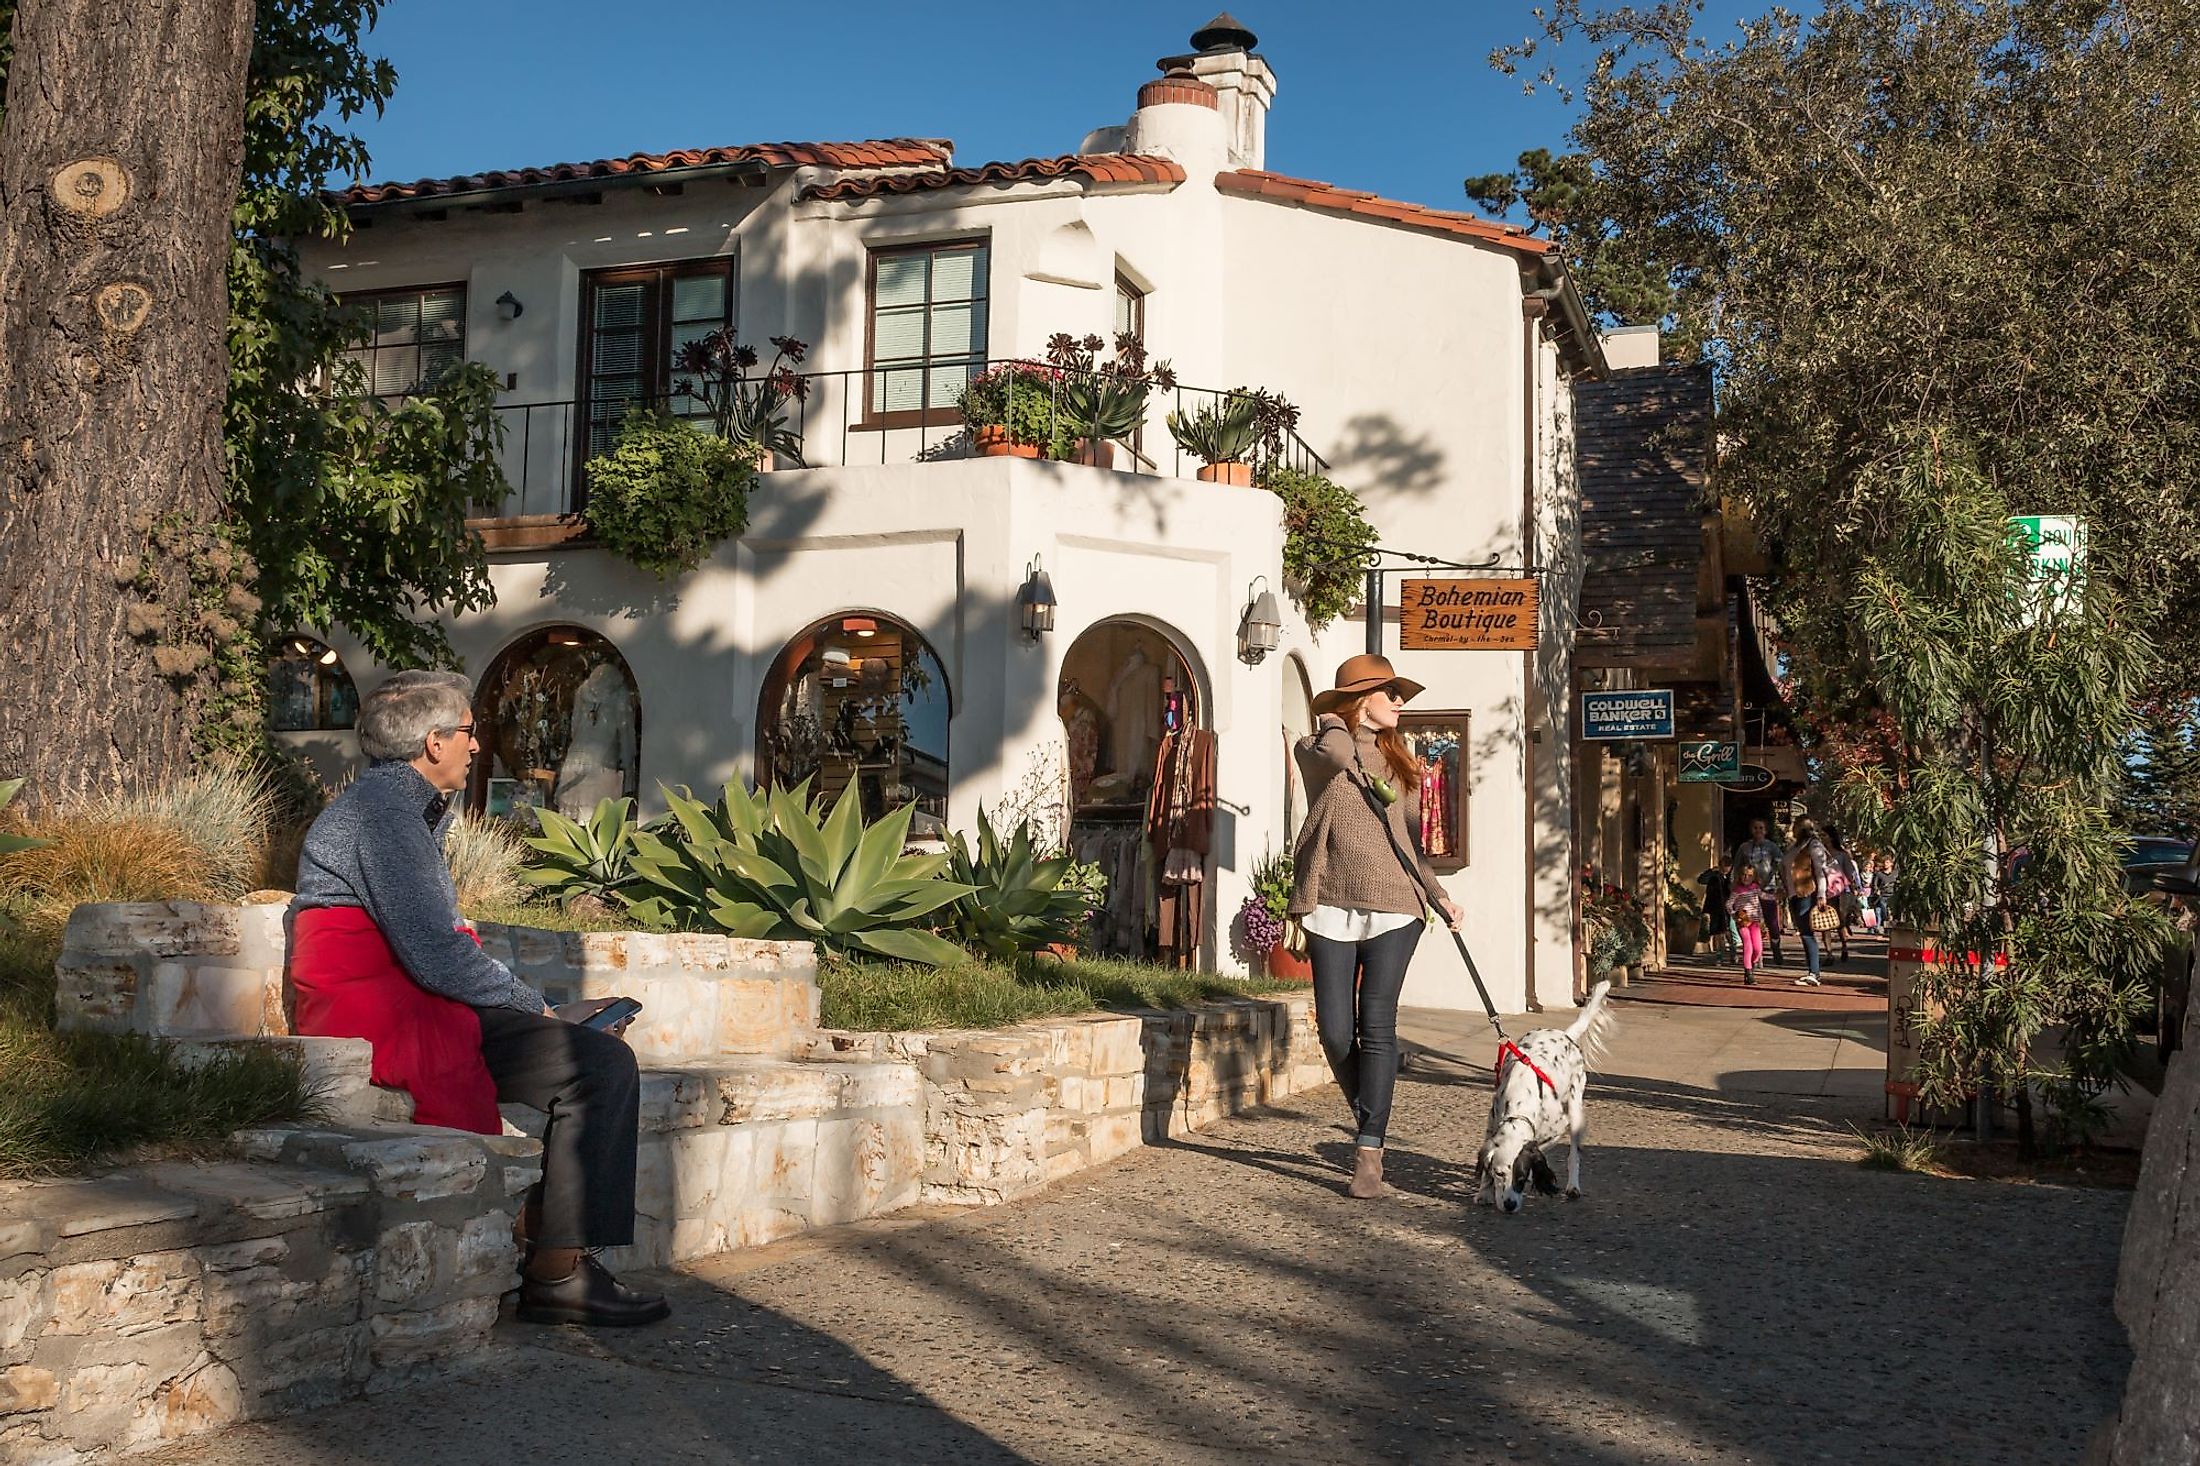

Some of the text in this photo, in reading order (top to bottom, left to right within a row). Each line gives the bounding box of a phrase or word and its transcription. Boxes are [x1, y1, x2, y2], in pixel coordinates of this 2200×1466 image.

[1418, 585, 1525, 606] Bohemian
[1421, 609, 1517, 632] Boutique
[1588, 699, 1666, 711] COLDWELL
[1590, 710, 1652, 722] BANKER
[1697, 744, 1734, 763] Grill
